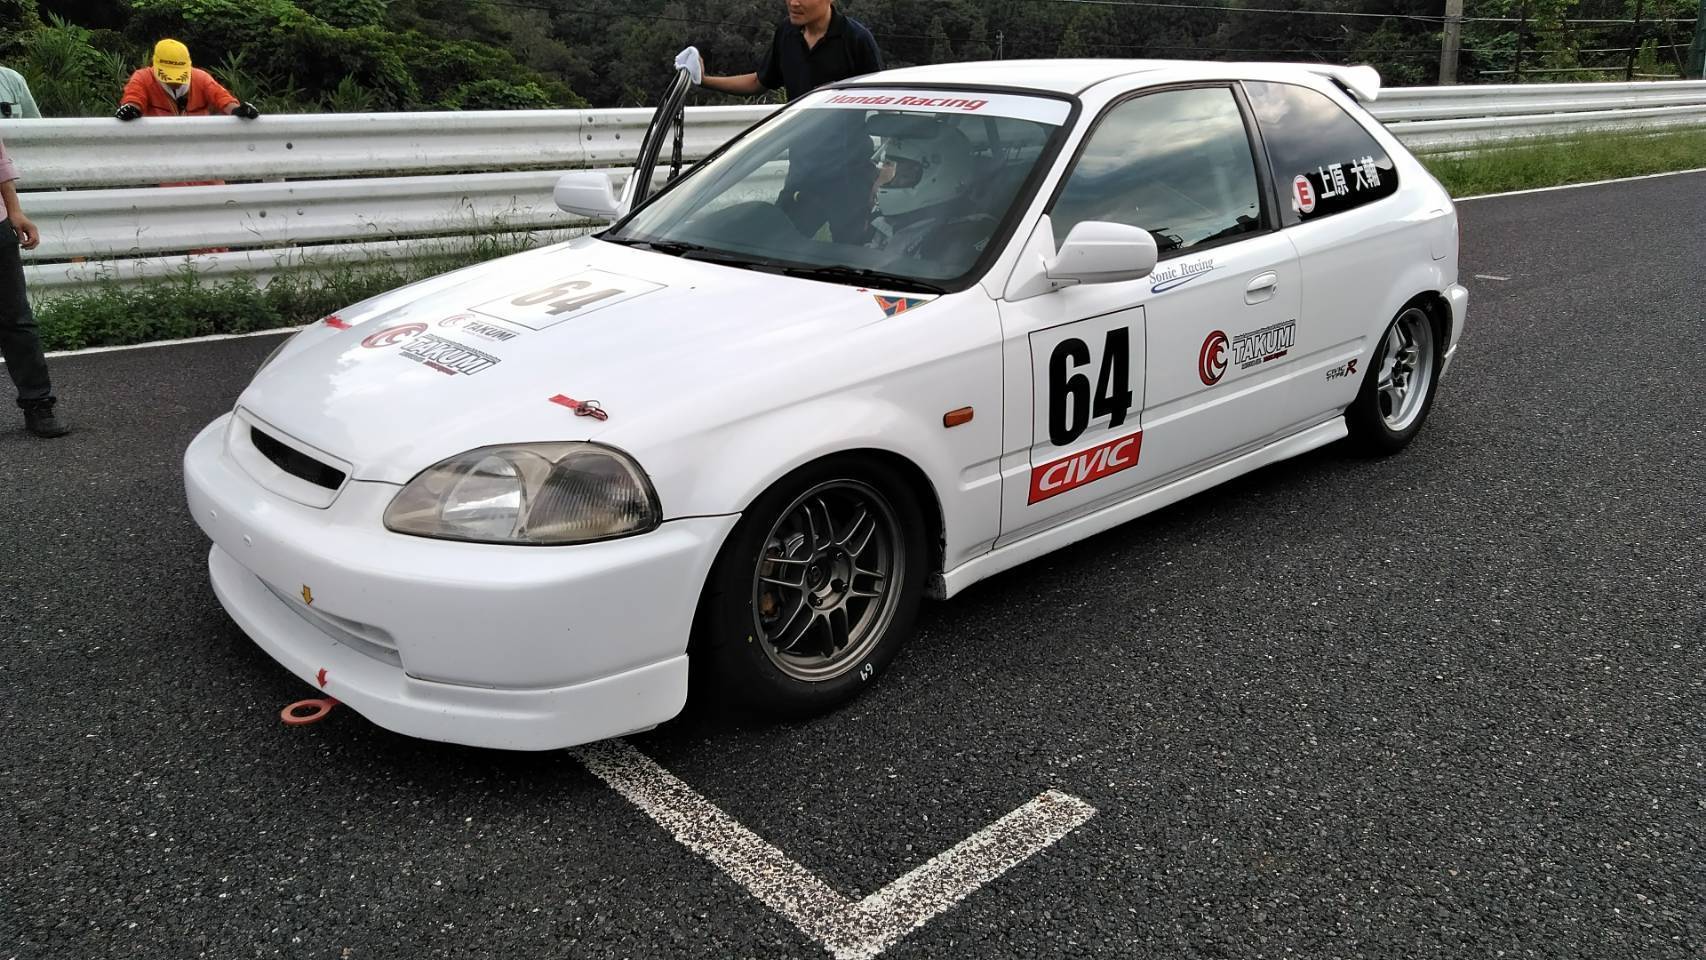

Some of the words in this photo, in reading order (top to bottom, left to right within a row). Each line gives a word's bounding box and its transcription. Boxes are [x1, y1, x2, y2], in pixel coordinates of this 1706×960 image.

[825, 95, 894, 106] Honda
[896, 95, 989, 111] Racing
[1296, 181, 1312, 205] E
[1318, 163, 1349, 199] 上原
[1149, 266, 1177, 284] Sonic
[1180, 258, 1214, 276] Racing
[510, 280, 626, 316] 64
[462, 321, 517, 342] TAKUMI
[1232, 322, 1296, 365] TAKUMI
[400, 336, 497, 375] TAKUMI
[1049, 326, 1132, 447] 64
[1039, 438, 1134, 492] CIVIC
